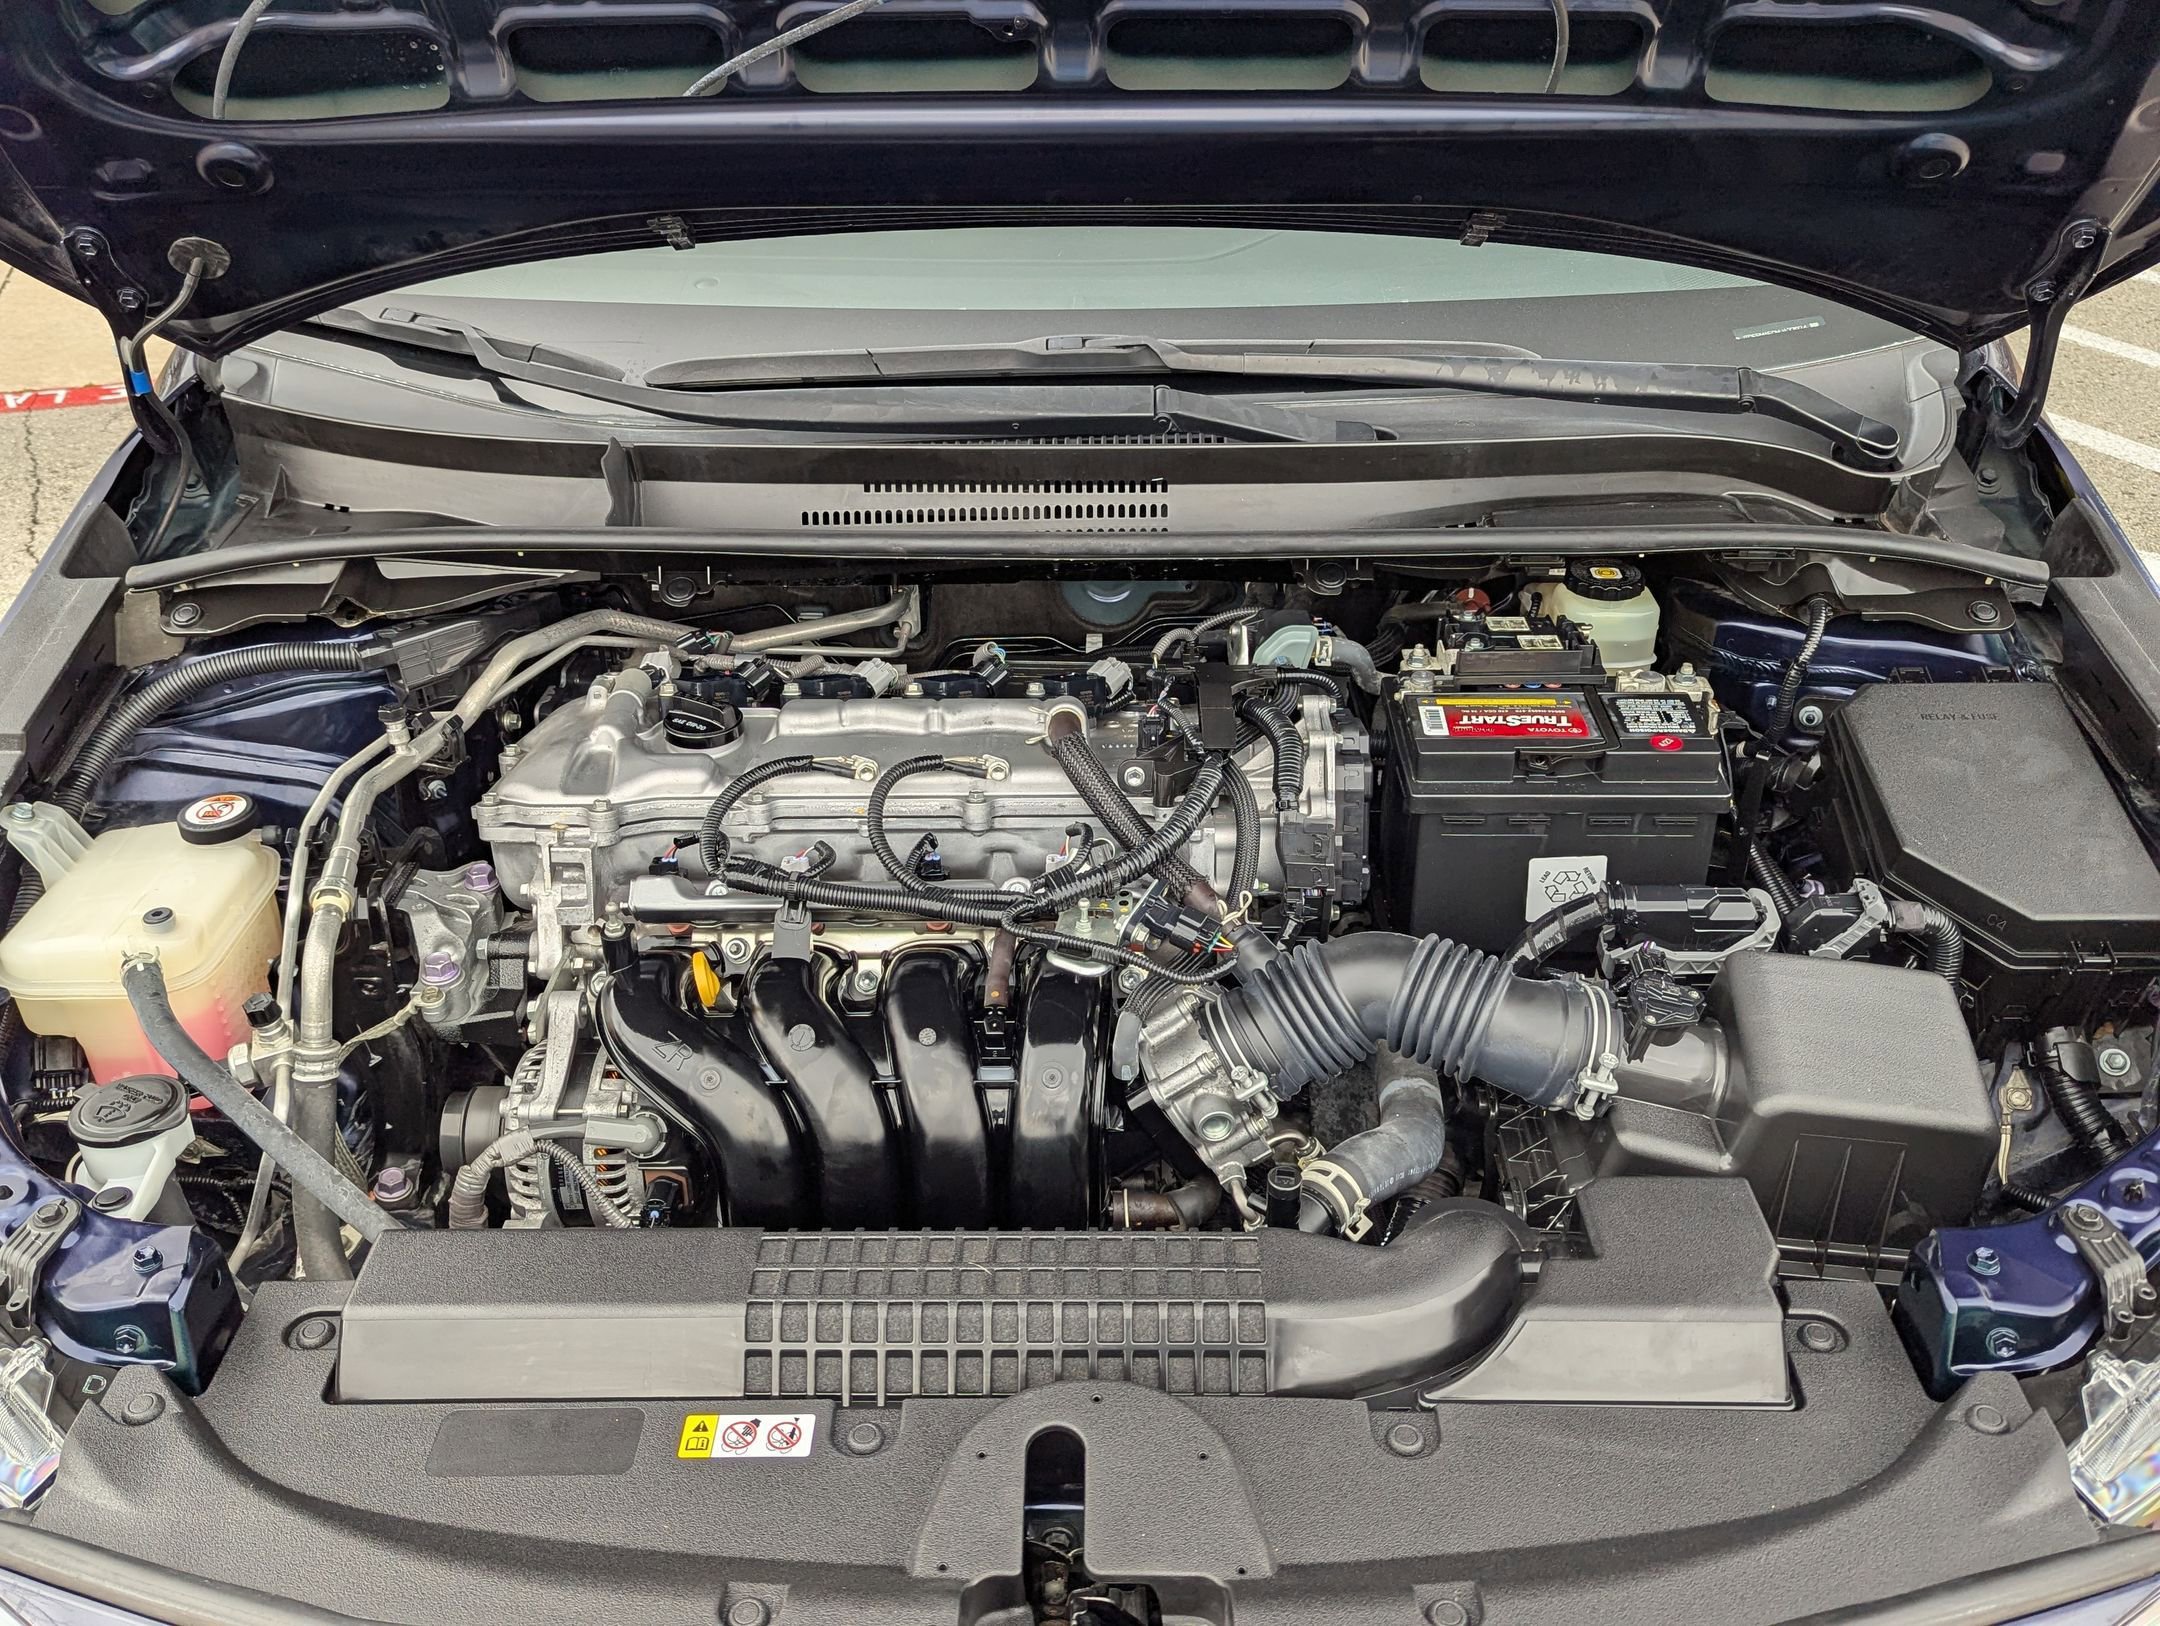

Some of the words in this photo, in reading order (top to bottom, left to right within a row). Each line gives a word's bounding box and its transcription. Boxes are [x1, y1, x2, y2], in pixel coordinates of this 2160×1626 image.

[1920, 713, 1956, 721] RELAY
[1970, 713, 1998, 721] FUSE
[1539, 870, 1551, 883] LEAD
[1582, 866, 1597, 885] RETURN
[651, 1030, 694, 1071] ZR
